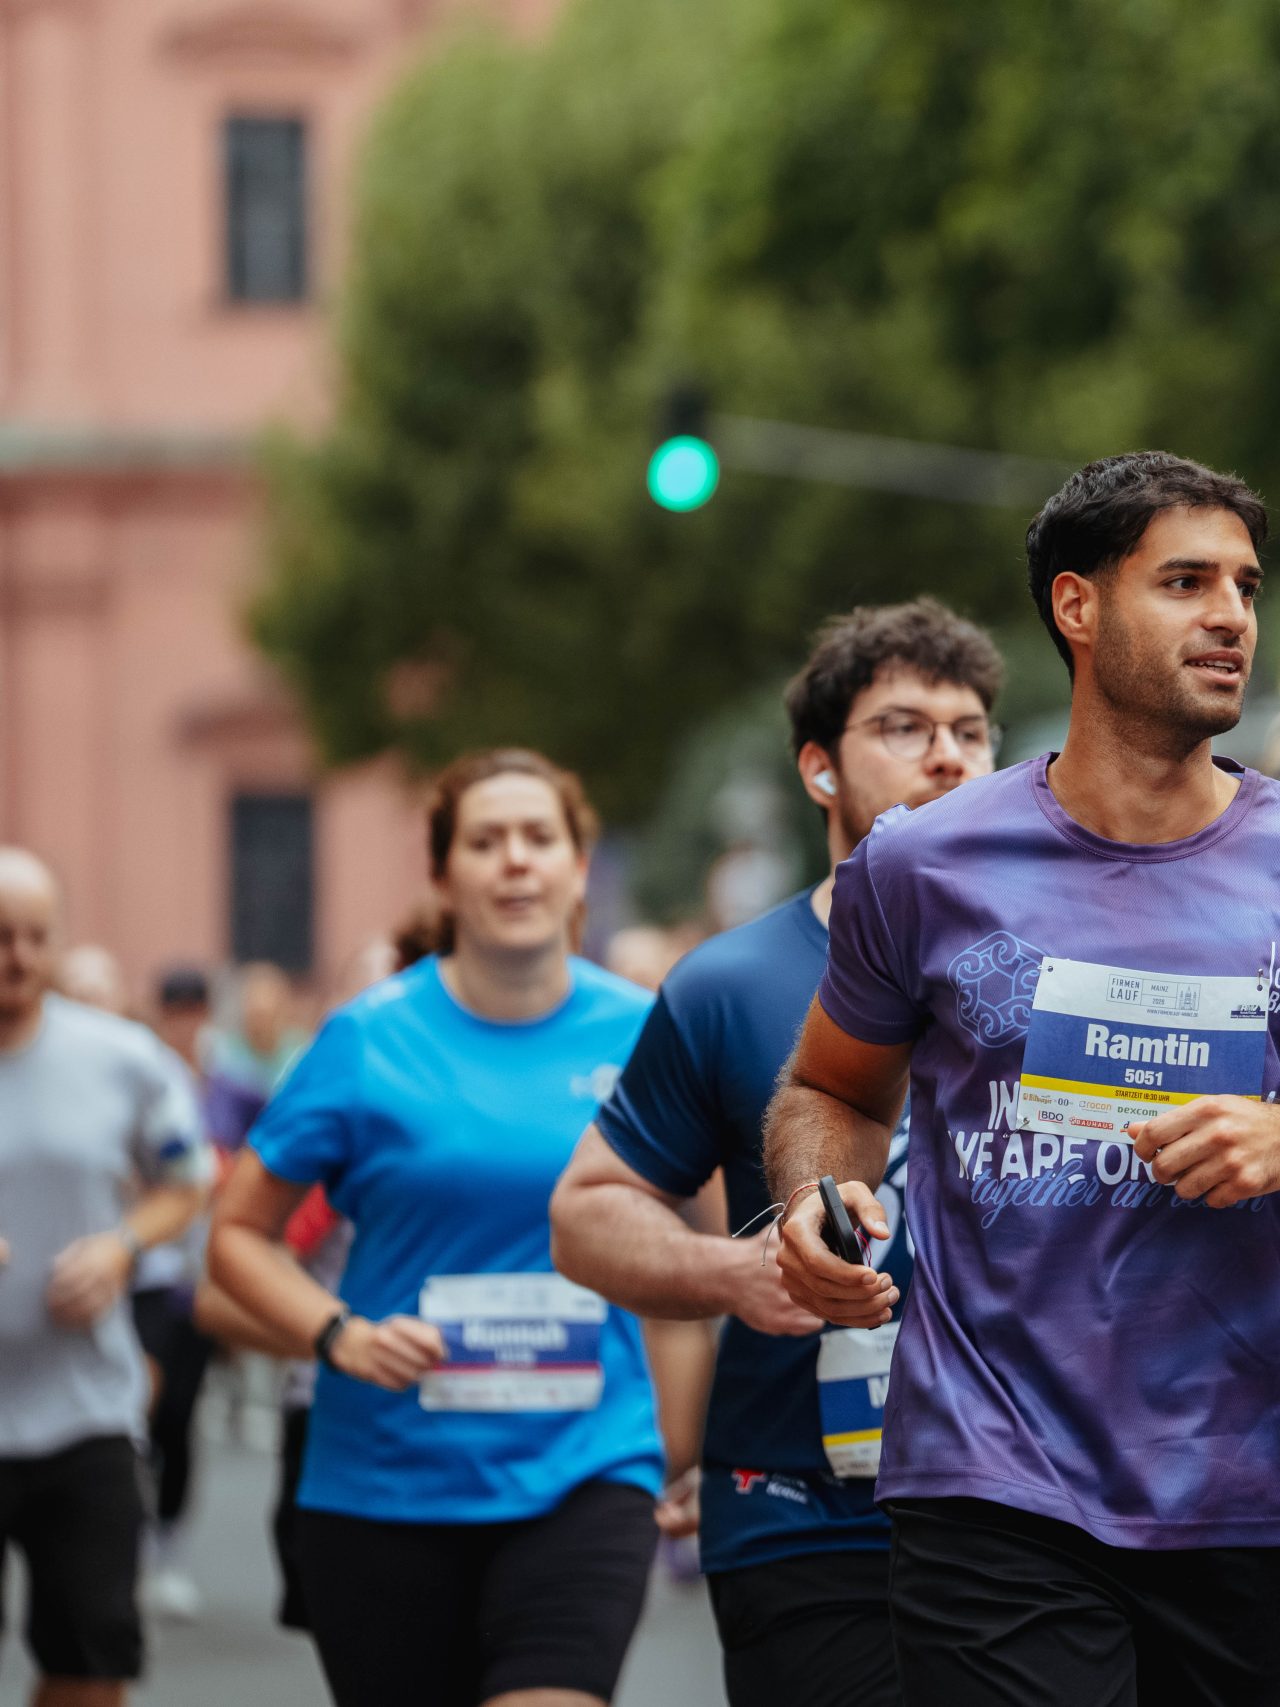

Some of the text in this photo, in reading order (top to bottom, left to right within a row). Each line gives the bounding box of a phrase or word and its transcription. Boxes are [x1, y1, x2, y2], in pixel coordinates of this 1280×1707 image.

[1112, 977, 1140, 989] FIRMEN
[1151, 984, 1169, 993] MAINZ
[1110, 987, 1139, 1001] LAUF
[1085, 1023, 1210, 1067] Ramtin
[1124, 1068, 1163, 1087] 5051
[1115, 1089, 1143, 1100] STARTZEIT
[1158, 1094, 1170, 1102] UHR
[1041, 1110, 1064, 1122] BDO
[1076, 1119, 1114, 1130] BAUHAUS
[970, 1159, 1102, 1230] together
